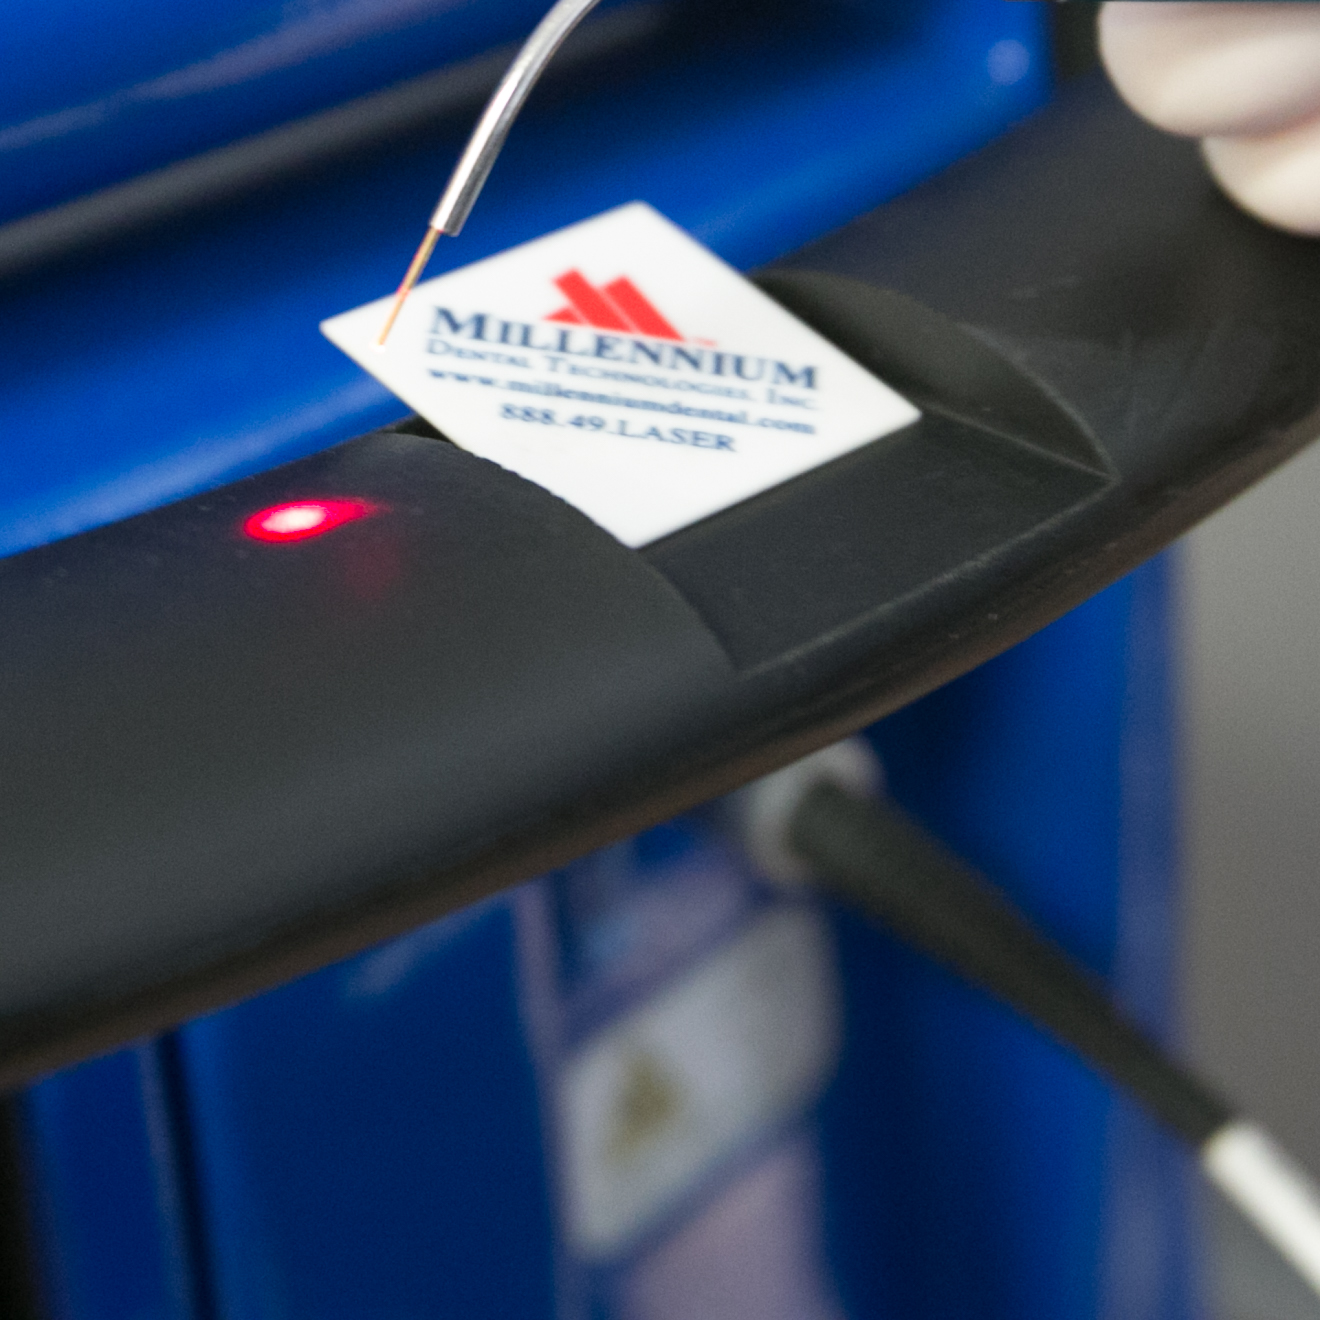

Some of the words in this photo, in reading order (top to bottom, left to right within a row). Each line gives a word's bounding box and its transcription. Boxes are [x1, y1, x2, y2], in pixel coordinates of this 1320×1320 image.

[429, 305, 819, 390] MILLENNIUM
[427, 368, 817, 435] www.millenniumdental.com
[500, 403, 738, 452] 888.49.LASER
